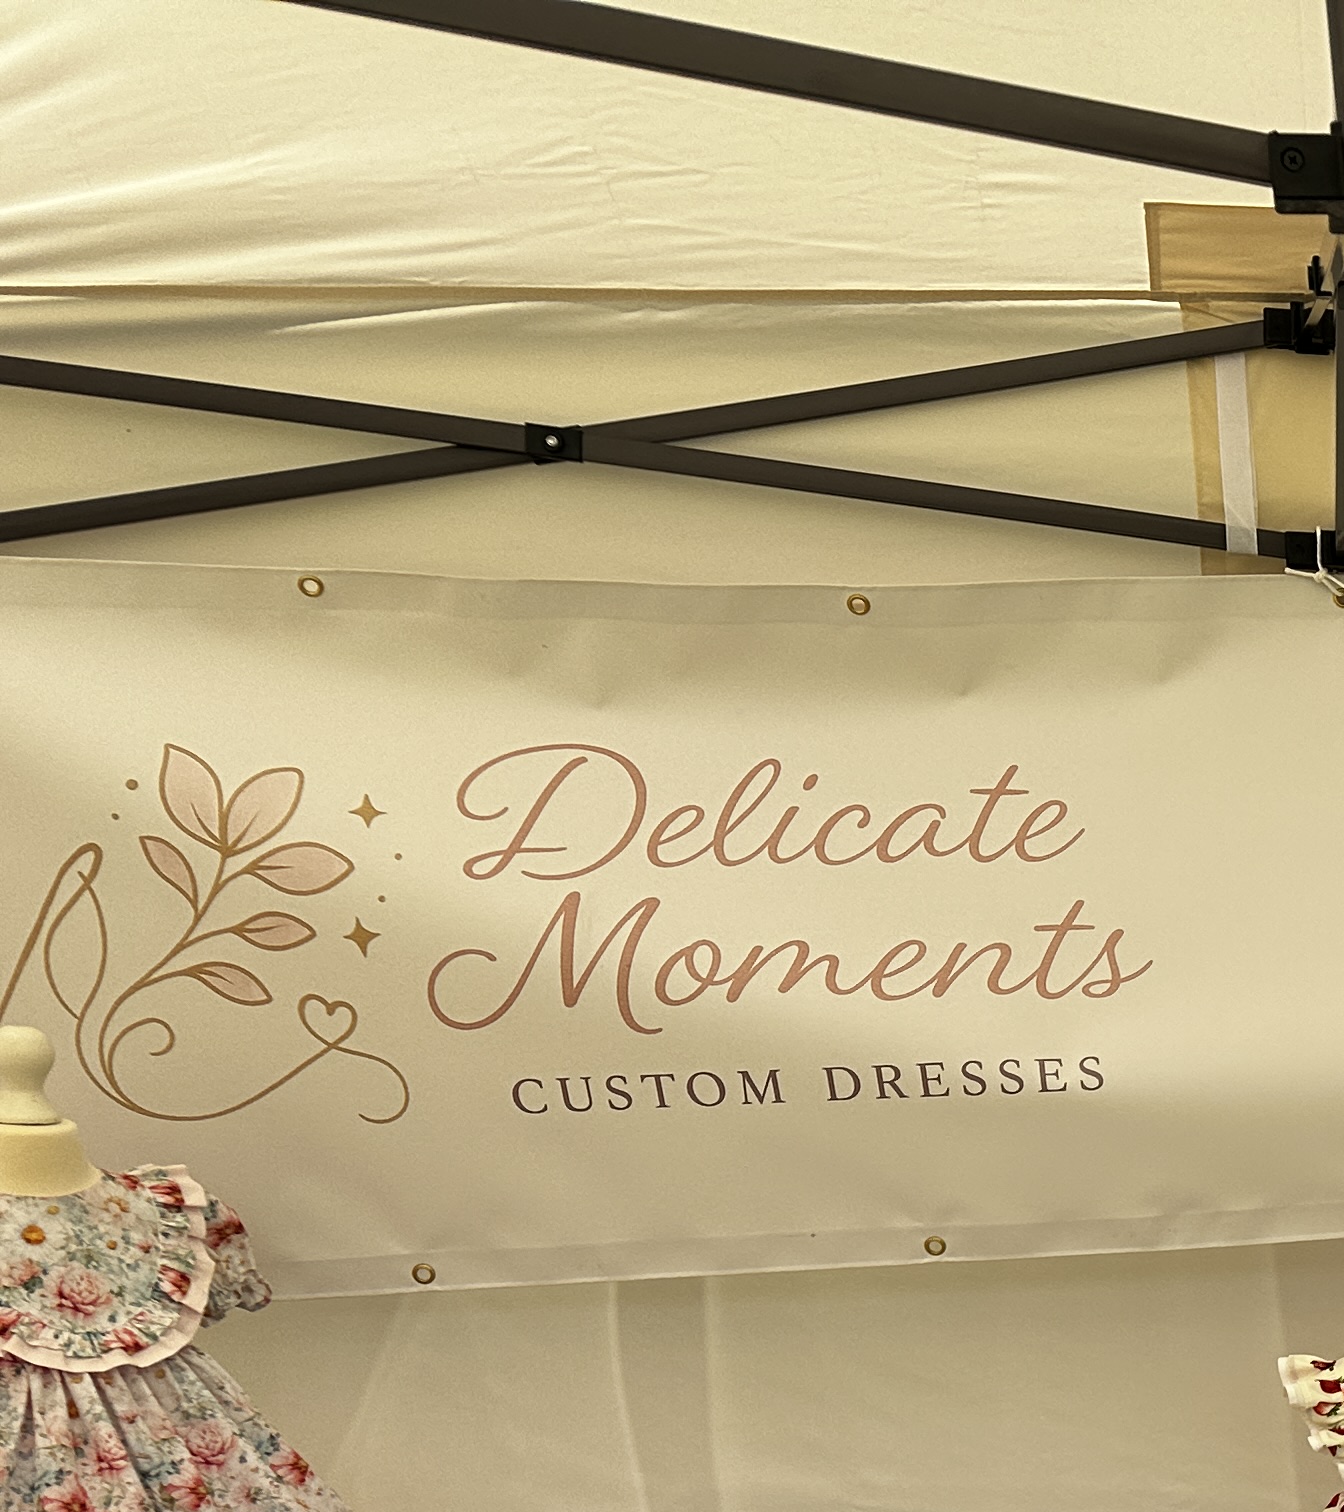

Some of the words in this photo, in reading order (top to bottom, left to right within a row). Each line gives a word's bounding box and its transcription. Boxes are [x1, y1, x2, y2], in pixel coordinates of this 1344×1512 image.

[456, 743, 1085, 881] Delicate
[427, 891, 1153, 1036] Moments
[511, 1067, 786, 1116] CUSTOM
[826, 1054, 1108, 1103] DRESSES
